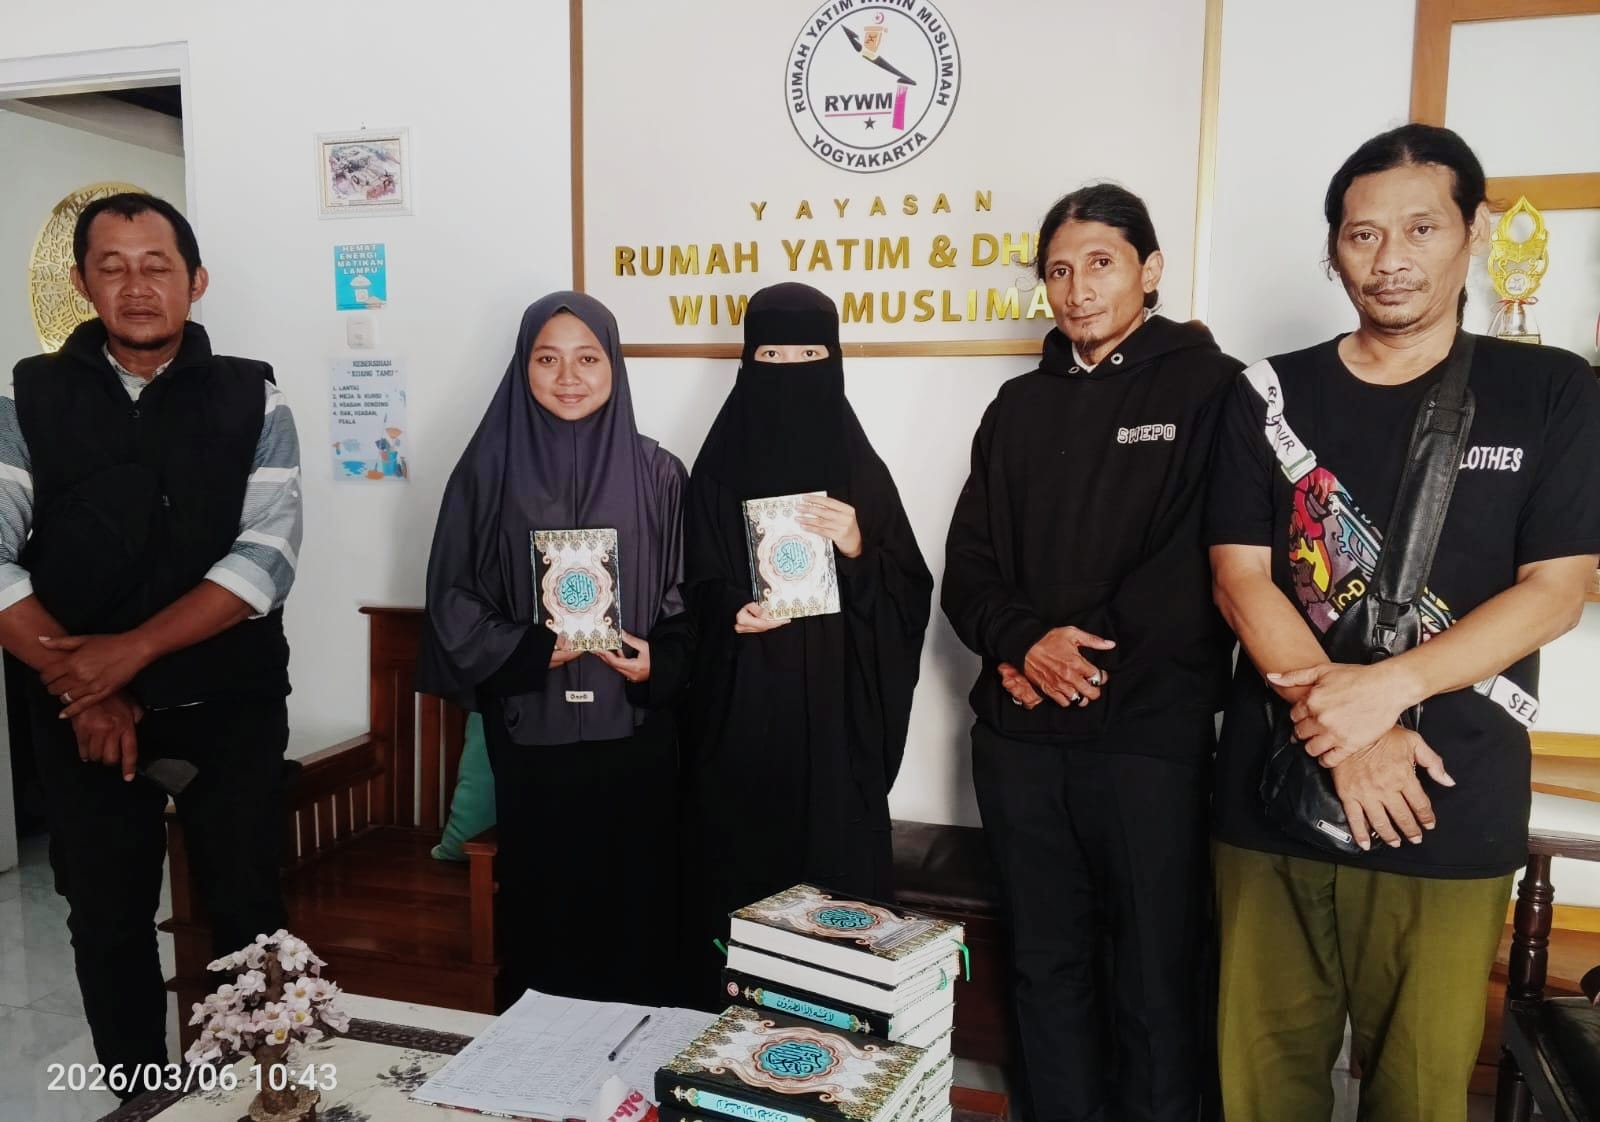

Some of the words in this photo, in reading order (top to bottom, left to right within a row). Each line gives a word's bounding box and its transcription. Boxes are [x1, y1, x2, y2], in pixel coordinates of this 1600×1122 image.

[792, 44, 811, 114] RUMAH
[806, 0, 854, 39] YATIM
[916, 6, 953, 107] MUSLIMAH
[825, 92, 893, 112] RYWM
[811, 132, 928, 168] YOGYAKARTA
[750, 190, 992, 221] YAYASAN
[339, 252, 377, 260] ENERGI
[342, 243, 377, 252] HEMAT
[614, 241, 759, 277] RUMAH
[781, 236, 910, 272] YATIM
[928, 234, 958, 268] &
[971, 232, 1049, 267] DH
[337, 259, 384, 267] MATIKAN
[343, 267, 378, 275] LAMPU
[1116, 423, 1176, 444] SWEPO
